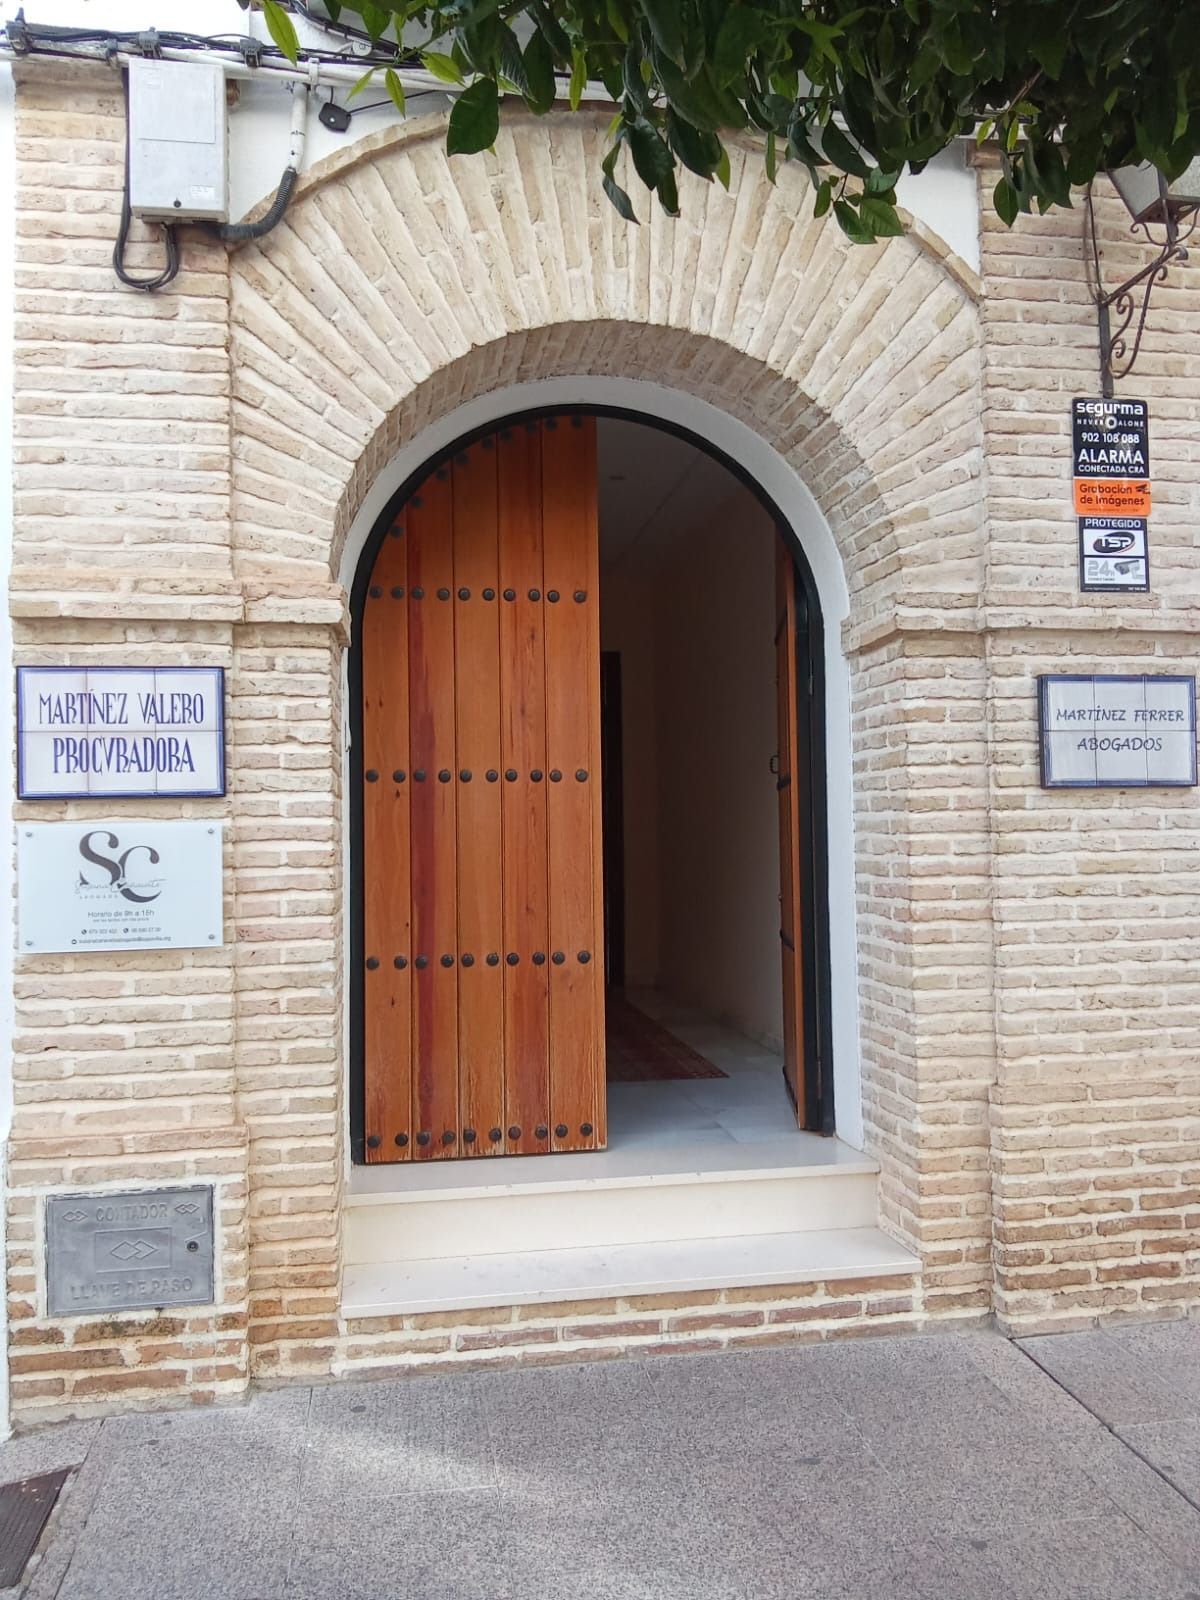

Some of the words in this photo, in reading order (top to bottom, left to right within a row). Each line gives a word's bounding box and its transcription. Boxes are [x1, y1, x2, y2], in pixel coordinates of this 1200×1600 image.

[1076, 402, 1144, 416] segurma
[1081, 431, 1100, 442] 902
[1121, 433, 1140, 444] 088
[1078, 448, 1145, 464] ALARMA
[1078, 464, 1127, 473] CONECTADA
[1128, 466, 1145, 474] CRA
[1079, 494, 1094, 504] de
[1085, 518, 1141, 528] PROTEGIDO
[1099, 536, 1132, 548] TSP
[137, 692, 205, 724] VALERO
[1134, 709, 1185, 723] FERRER
[1076, 737, 1163, 753] ABOGADOS
[95, 1203, 168, 1223] CONTADOR
[151, 1277, 193, 1295] PASO
